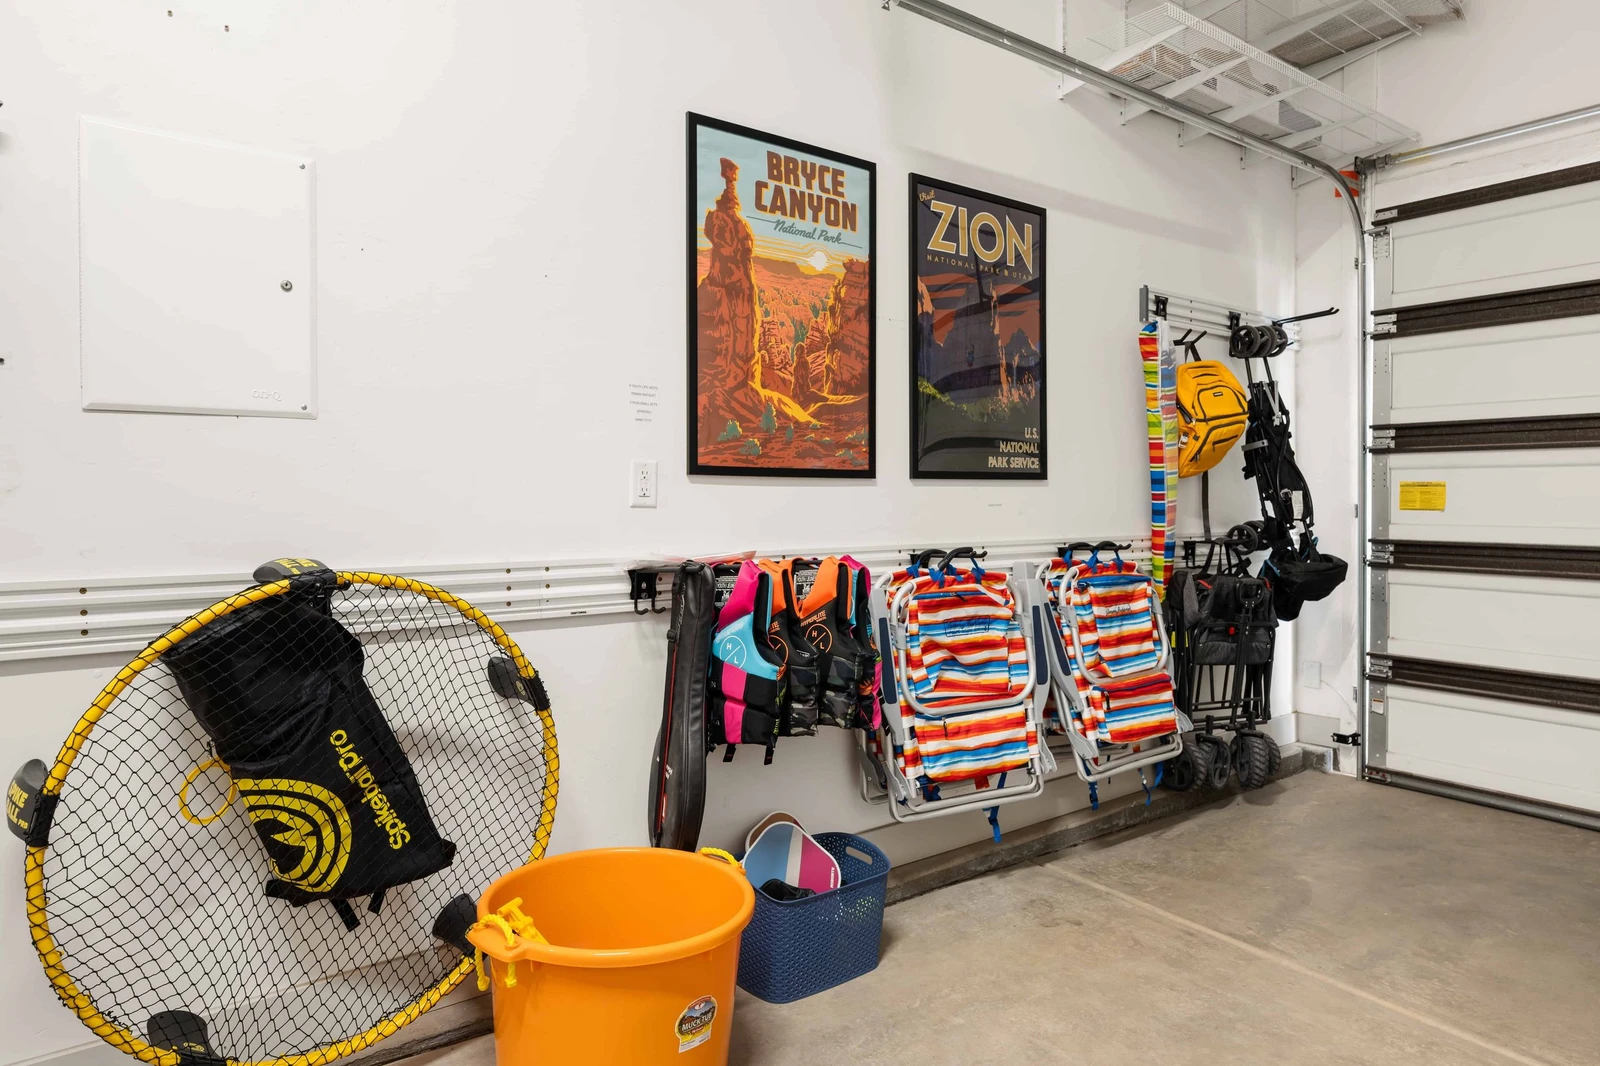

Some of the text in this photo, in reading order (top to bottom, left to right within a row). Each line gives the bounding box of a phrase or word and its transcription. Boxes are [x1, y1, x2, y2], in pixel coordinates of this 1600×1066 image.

[766, 150, 846, 199] BRYCE
[754, 180, 858, 233] CANYON
[773, 219, 843, 245] National Park
[927, 199, 1033, 275] ZION
[926, 254, 975, 270] NATIONAL
[1024, 427, 1039, 439] U.S.
[999, 440, 1039, 454] NATIONAL
[988, 455, 1039, 469] PARK SERVICE
[734, 656, 739, 664] L
[329, 729, 411, 850] Spikeball Pro
[681, 1017, 702, 1032] MUCK
